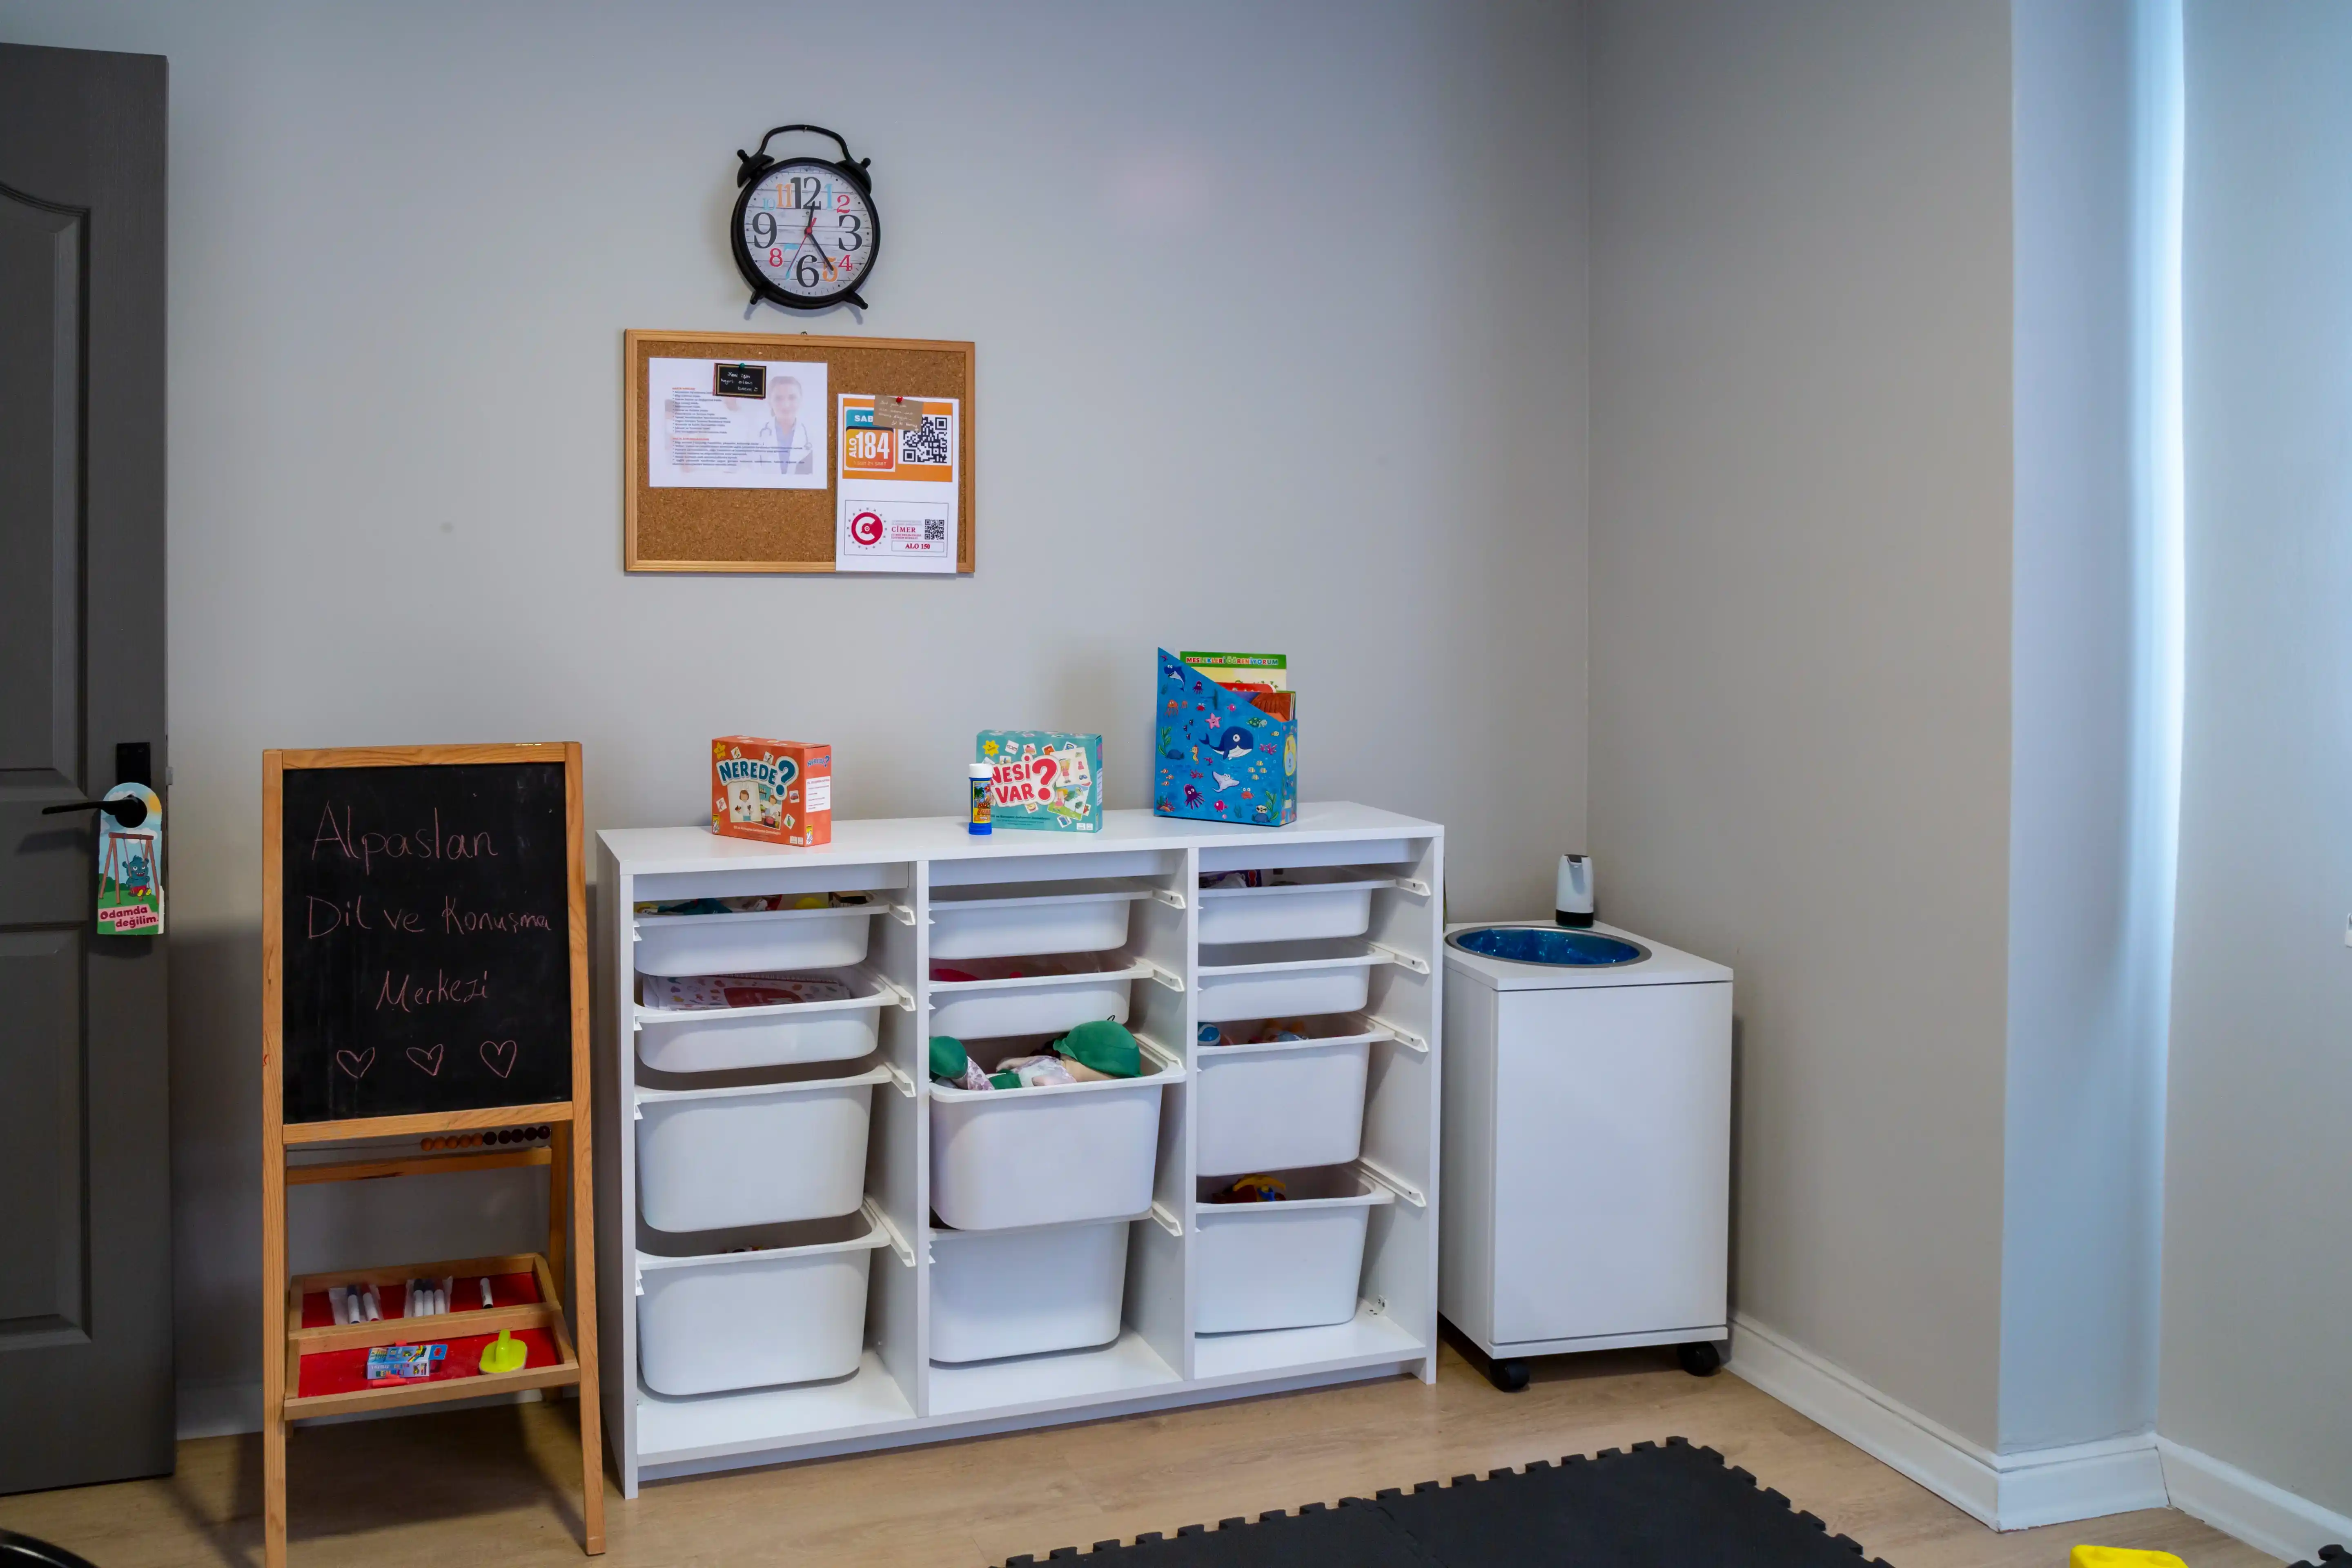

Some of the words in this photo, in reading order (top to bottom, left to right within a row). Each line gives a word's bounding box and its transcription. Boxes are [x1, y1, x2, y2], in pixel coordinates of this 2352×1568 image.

[763, 198, 775, 211] 10
[775, 184, 793, 208] 11
[790, 177, 821, 209] 12
[824, 183, 833, 209] 1
[837, 195, 851, 214] 2
[752, 212, 777, 249] 9
[839, 214, 863, 252] 3
[769, 248, 783, 267] 8
[784, 243, 800, 281] 7
[823, 257, 838, 282] 5
[839, 254, 853, 272] 4
[796, 254, 820, 288] 6
[855, 432, 890, 459] 184
[1226, 656, 1278, 665] ÖĞRENİYORUM
[719, 760, 795, 796] NEREDE?
[312, 800, 498, 875] Alpaslan
[100, 906, 148, 920] Odamda
[116, 916, 159, 928] değilim.
[306, 895, 372, 938] Dil
[384, 909, 425, 932] ve
[441, 895, 552, 935] Konuşma
[376, 969, 488, 1012] Merkezi
